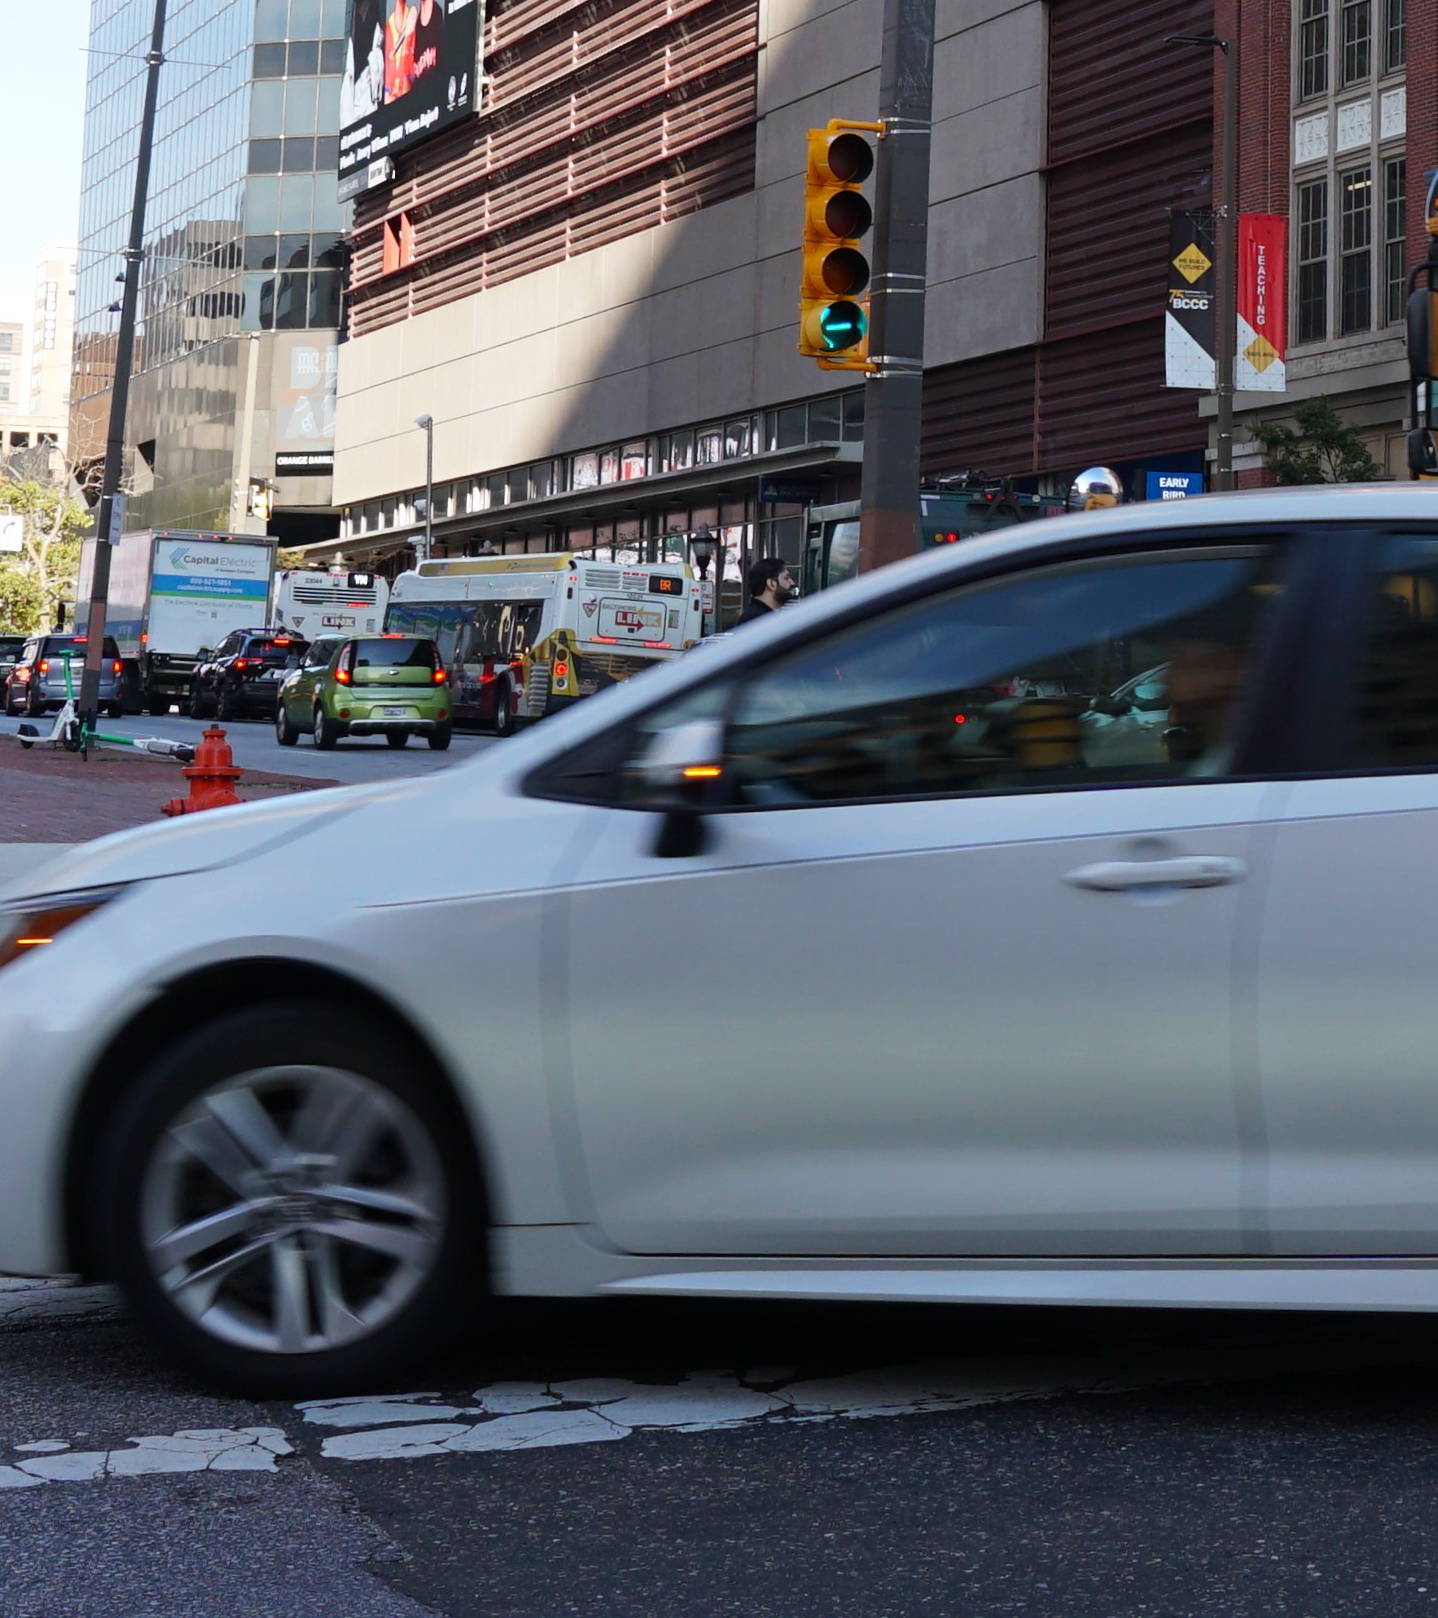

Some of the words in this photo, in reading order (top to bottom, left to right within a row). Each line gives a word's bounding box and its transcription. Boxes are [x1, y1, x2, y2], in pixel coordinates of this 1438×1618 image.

[1256, 245, 1266, 325] TEACHING
[1169, 289, 1184, 303] 75
[1172, 298, 1209, 310] BCCC
[1159, 477, 1189, 488] EARLY
[1163, 491, 1186, 500] BIRD
[183, 555, 218, 565] Capital
[220, 557, 257, 567] Electric
[323, 616, 355, 626] LINK
[617, 612, 661, 627] LINK
